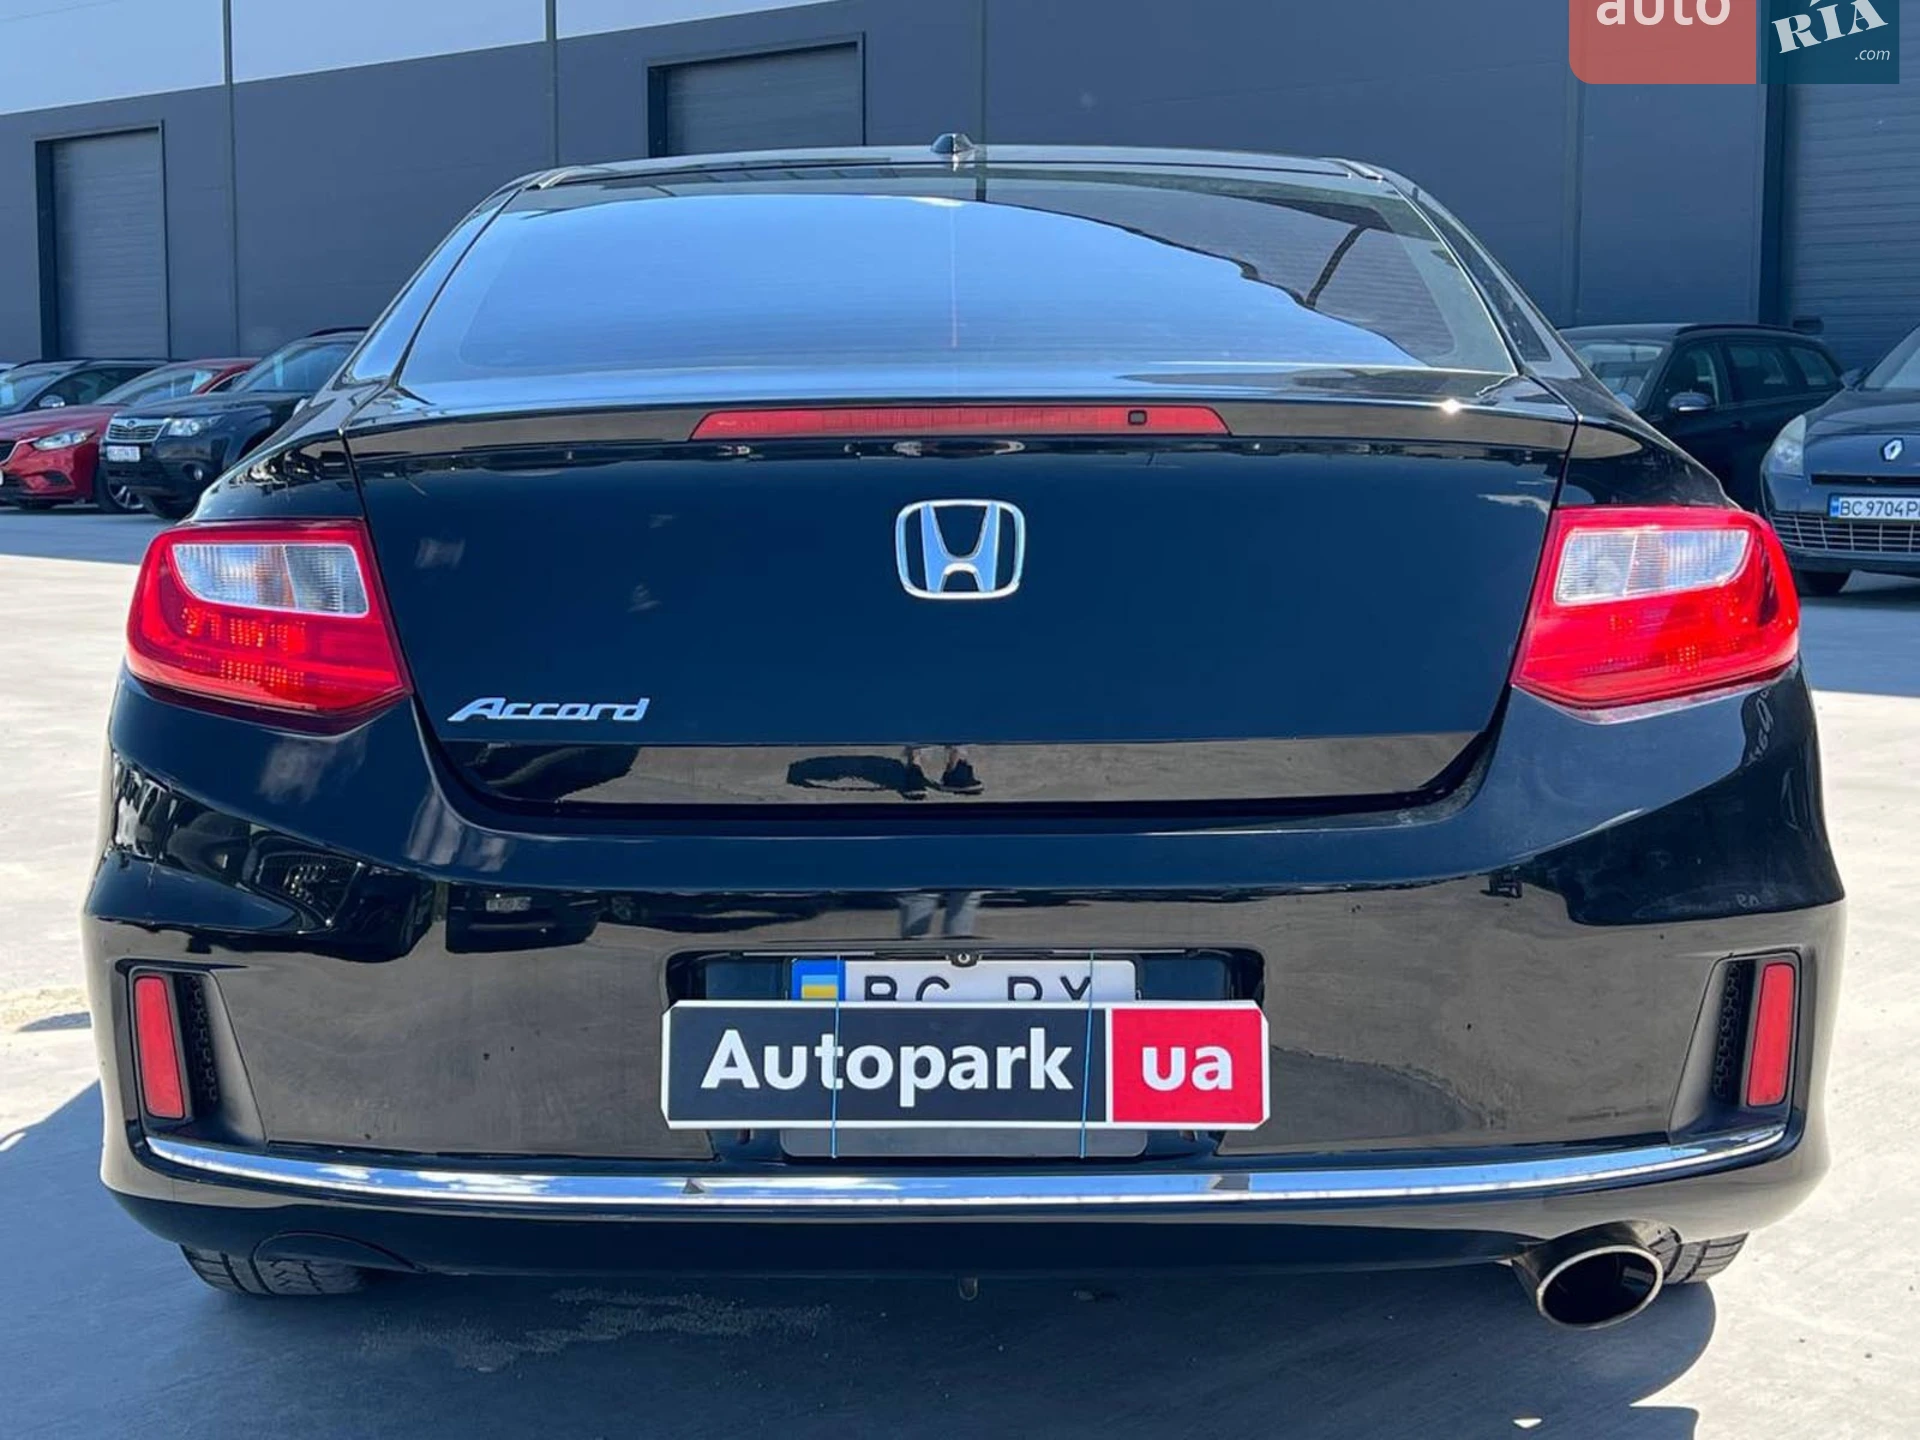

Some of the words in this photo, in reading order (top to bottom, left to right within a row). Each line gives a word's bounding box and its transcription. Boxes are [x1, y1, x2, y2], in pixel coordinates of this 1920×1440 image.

[447, 697, 650, 721] Accord
[700, 1027, 1073, 1108] Autopark
[1141, 1046, 1234, 1091] ua
